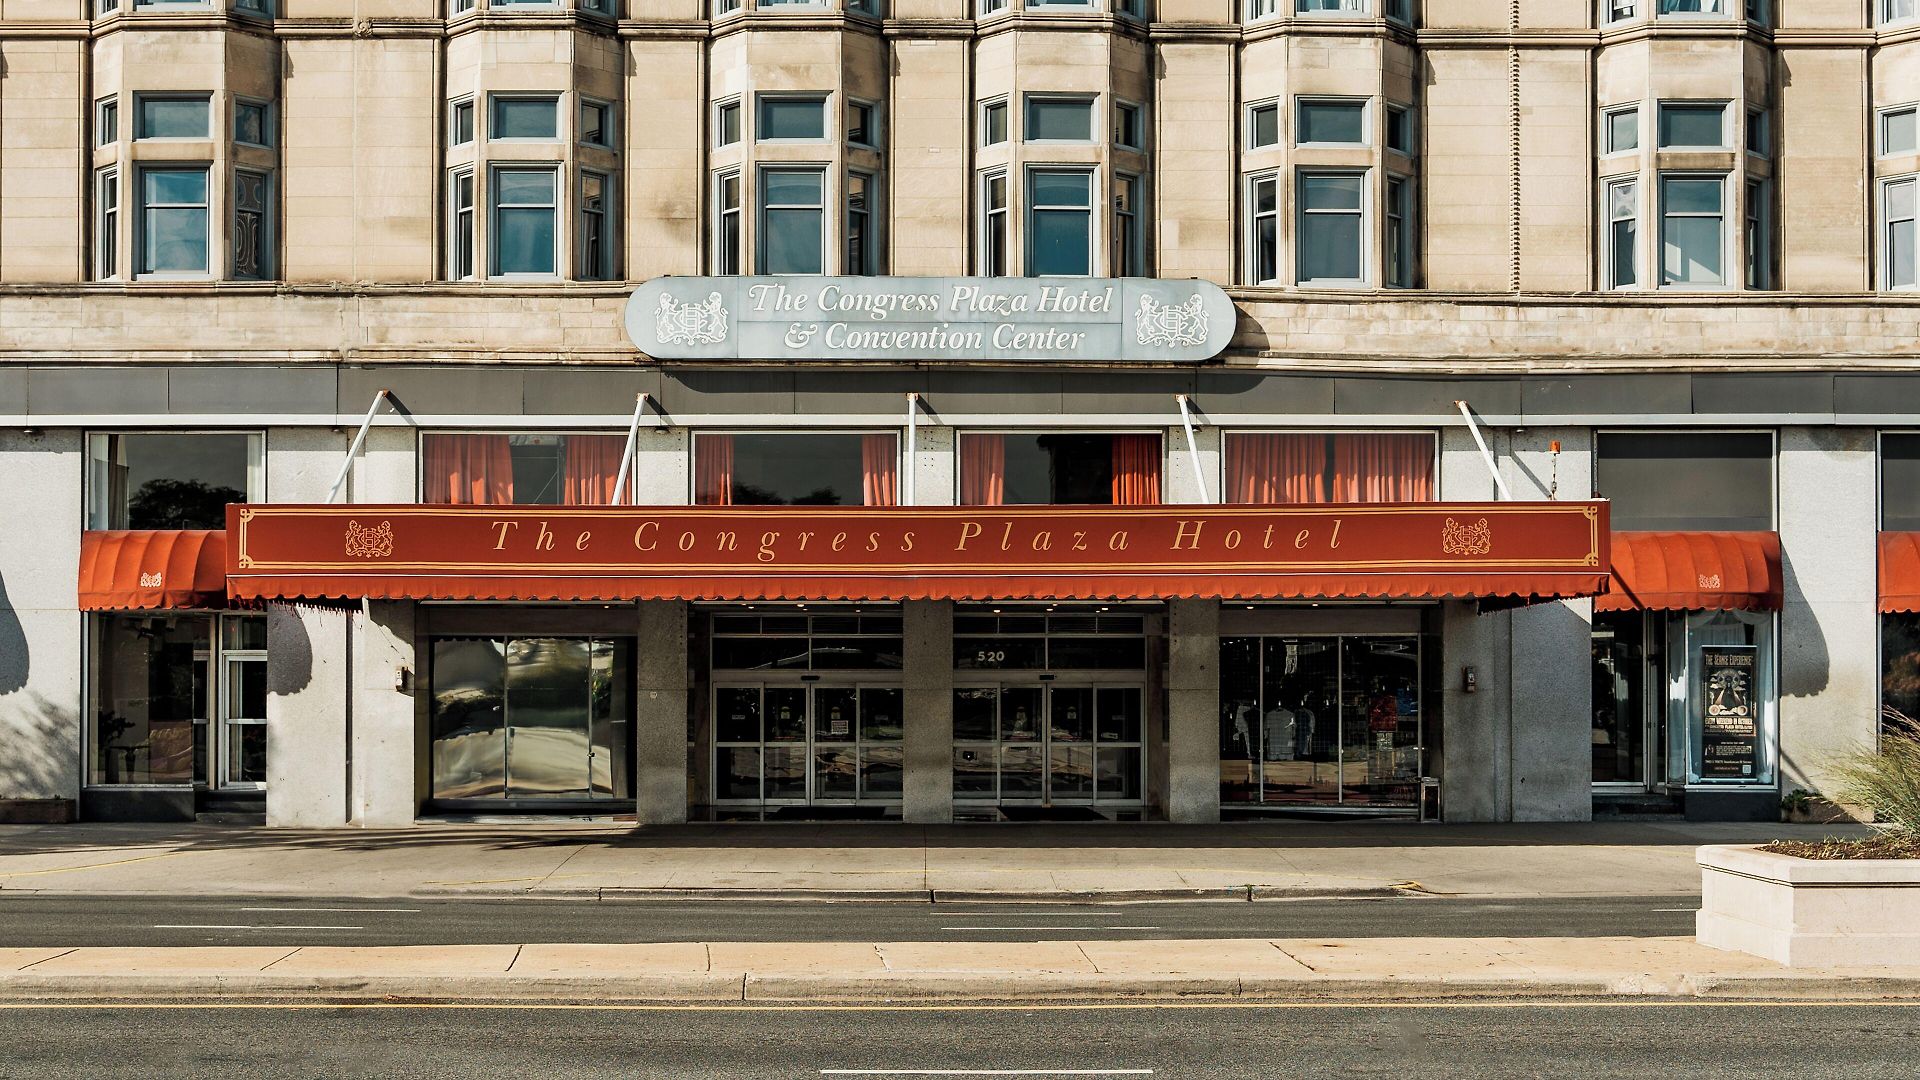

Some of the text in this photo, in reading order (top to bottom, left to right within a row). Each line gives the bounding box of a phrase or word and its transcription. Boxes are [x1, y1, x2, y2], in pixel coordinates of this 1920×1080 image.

[748, 283, 1113, 320] The Congress Plaza Hotel
[784, 322, 1085, 349] & Convention Center
[491, 519, 1342, 562] The Congress Plaza Hotel
[977, 651, 1005, 662] 520
